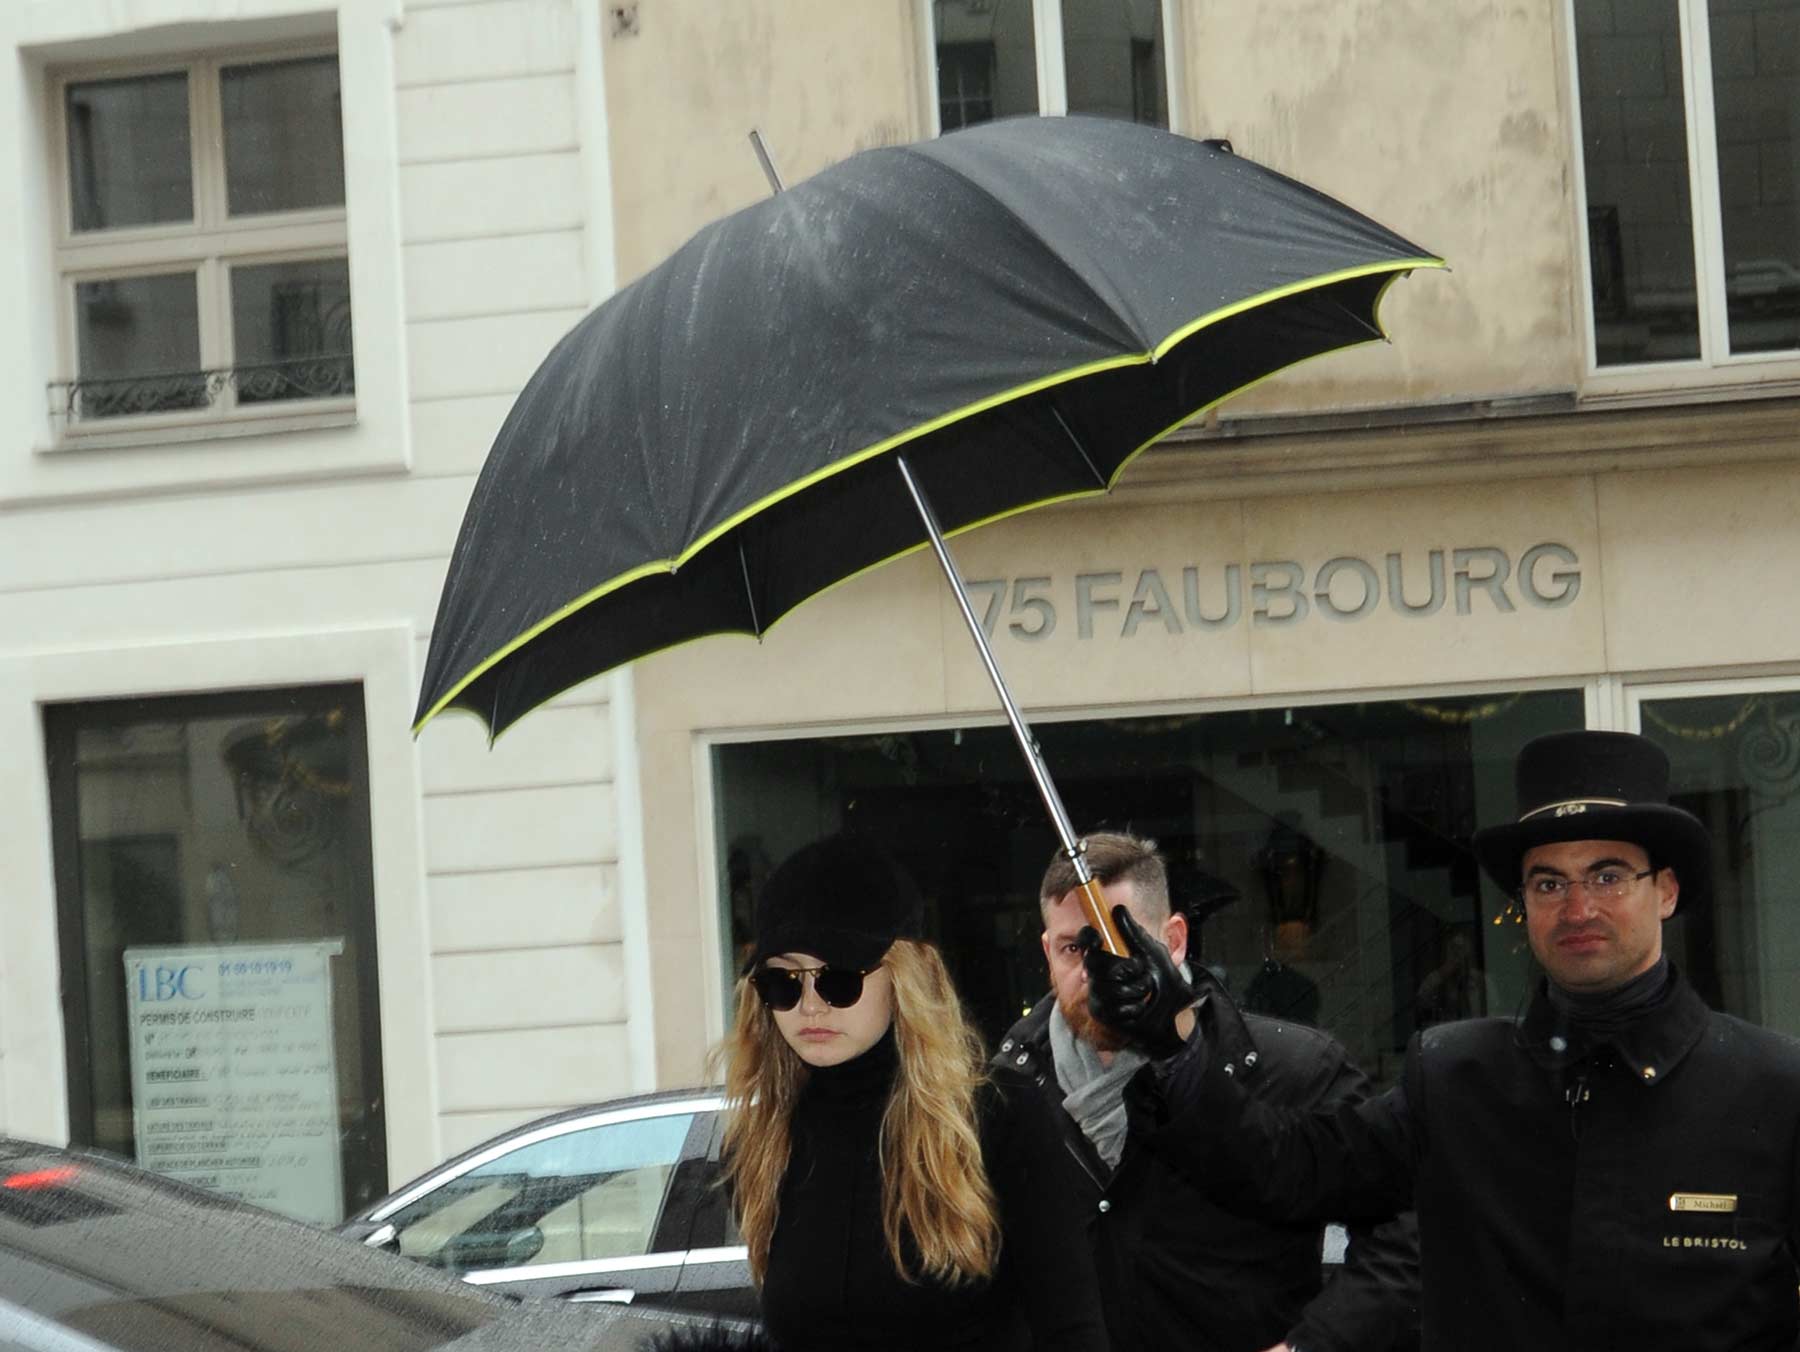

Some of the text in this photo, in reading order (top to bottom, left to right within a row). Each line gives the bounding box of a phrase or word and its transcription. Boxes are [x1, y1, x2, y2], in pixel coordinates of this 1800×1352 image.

[965, 542, 1582, 642] 75 FAUBOURG
[1663, 1237, 1747, 1250] LE BRISTOL
